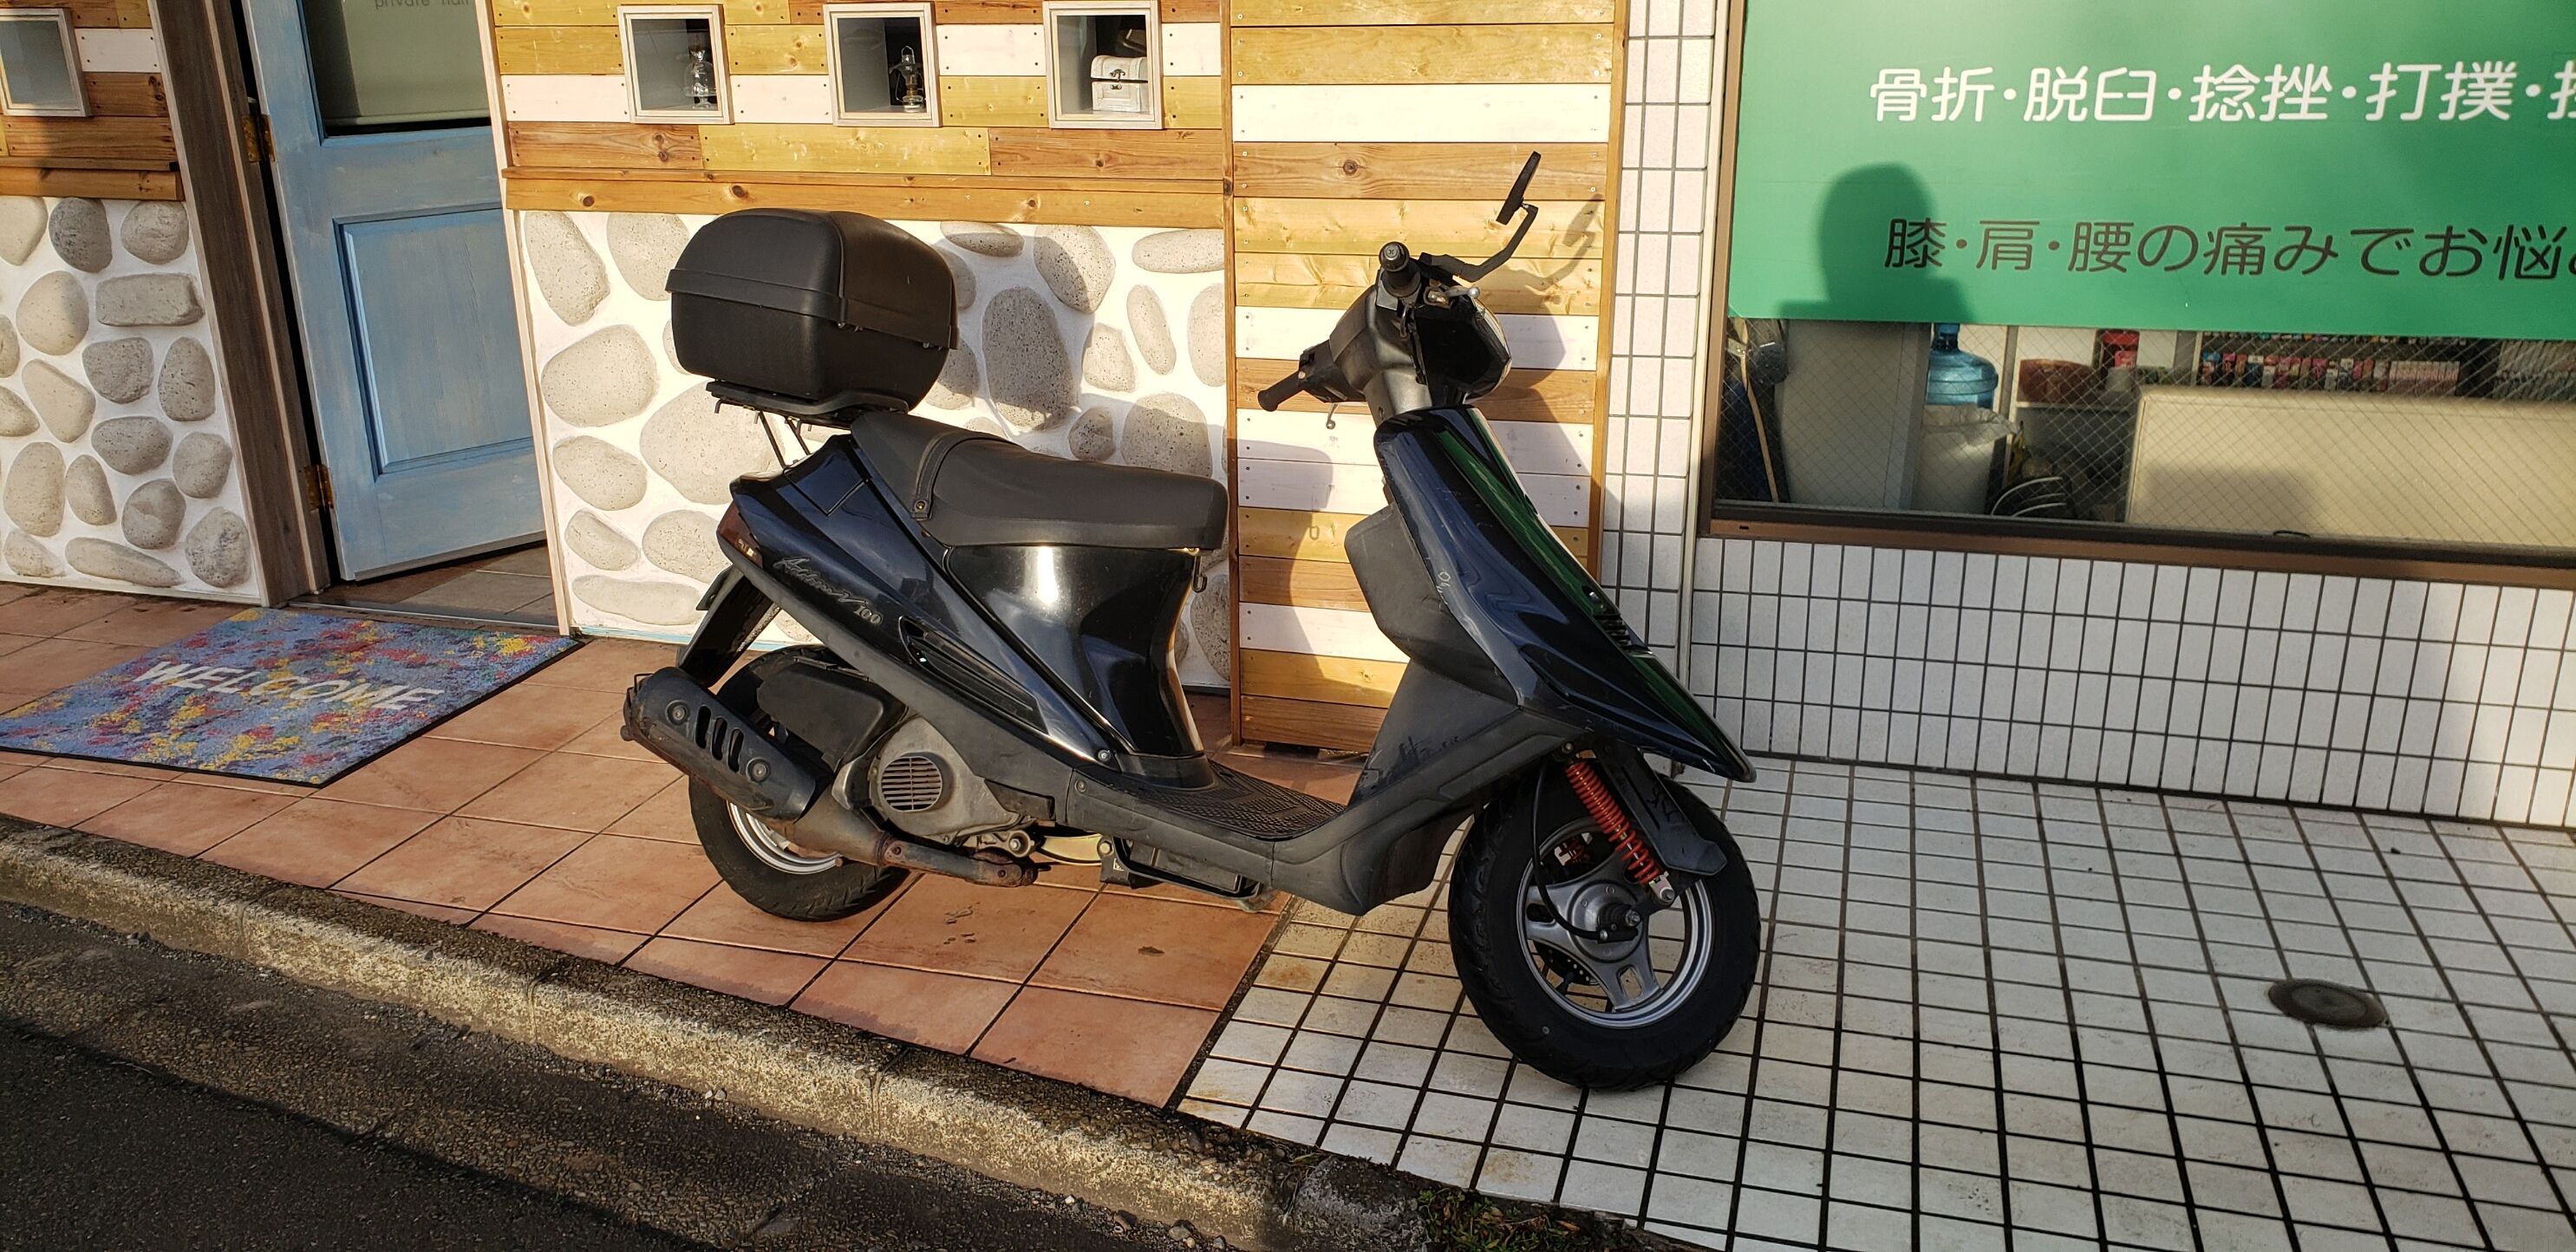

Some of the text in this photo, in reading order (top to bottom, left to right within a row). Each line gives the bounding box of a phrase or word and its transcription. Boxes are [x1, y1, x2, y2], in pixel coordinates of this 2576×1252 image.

[1884, 217, 2576, 281] 膝・肩・腰の痛みでお悩
[133, 661, 445, 710] WELCOME
